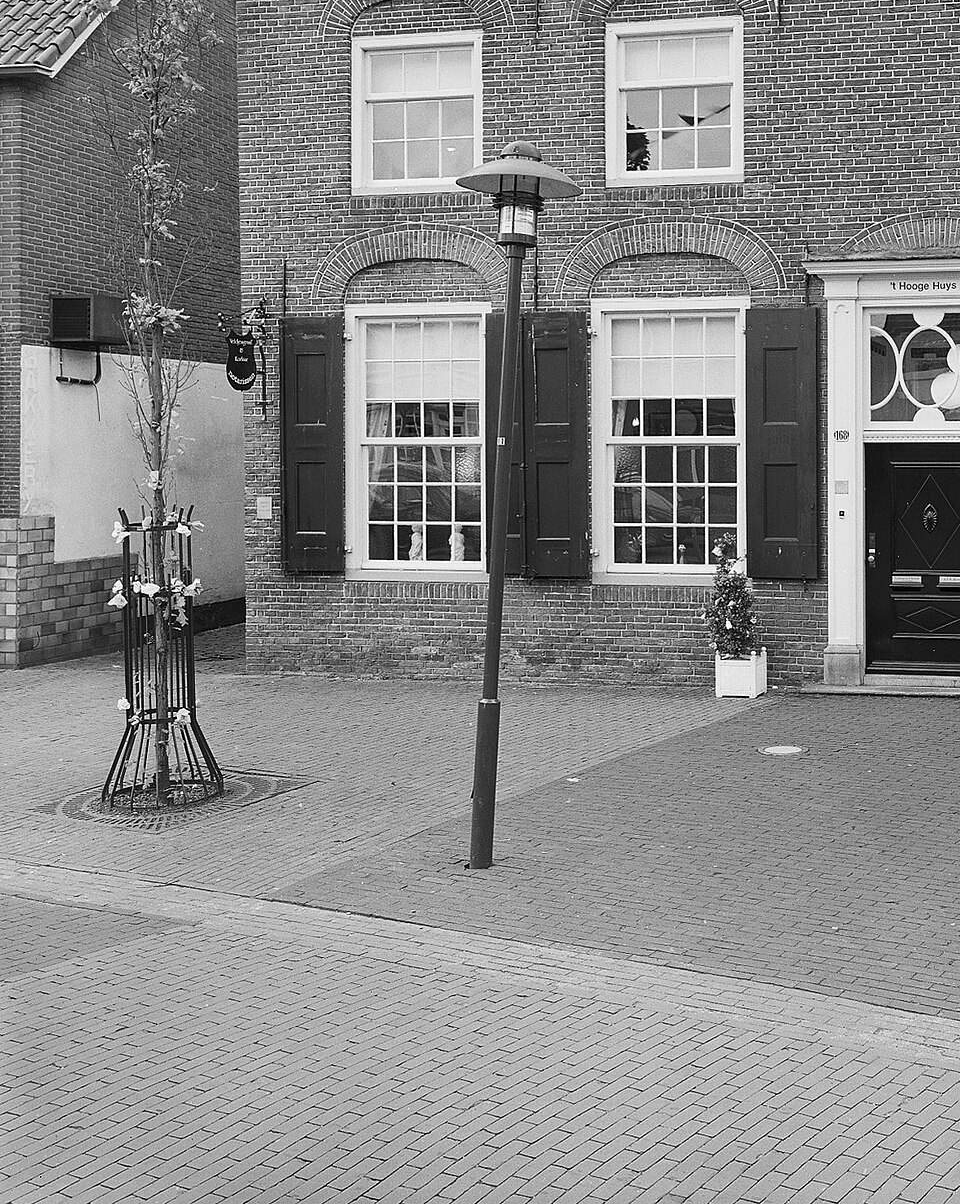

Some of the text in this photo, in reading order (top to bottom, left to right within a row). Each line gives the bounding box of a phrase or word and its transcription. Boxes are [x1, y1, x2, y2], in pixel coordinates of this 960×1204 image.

[890, 281, 957, 292] 't Hooge Huys
[228, 370, 256, 385] notarissen
[835, 430, 848, 441] 168
